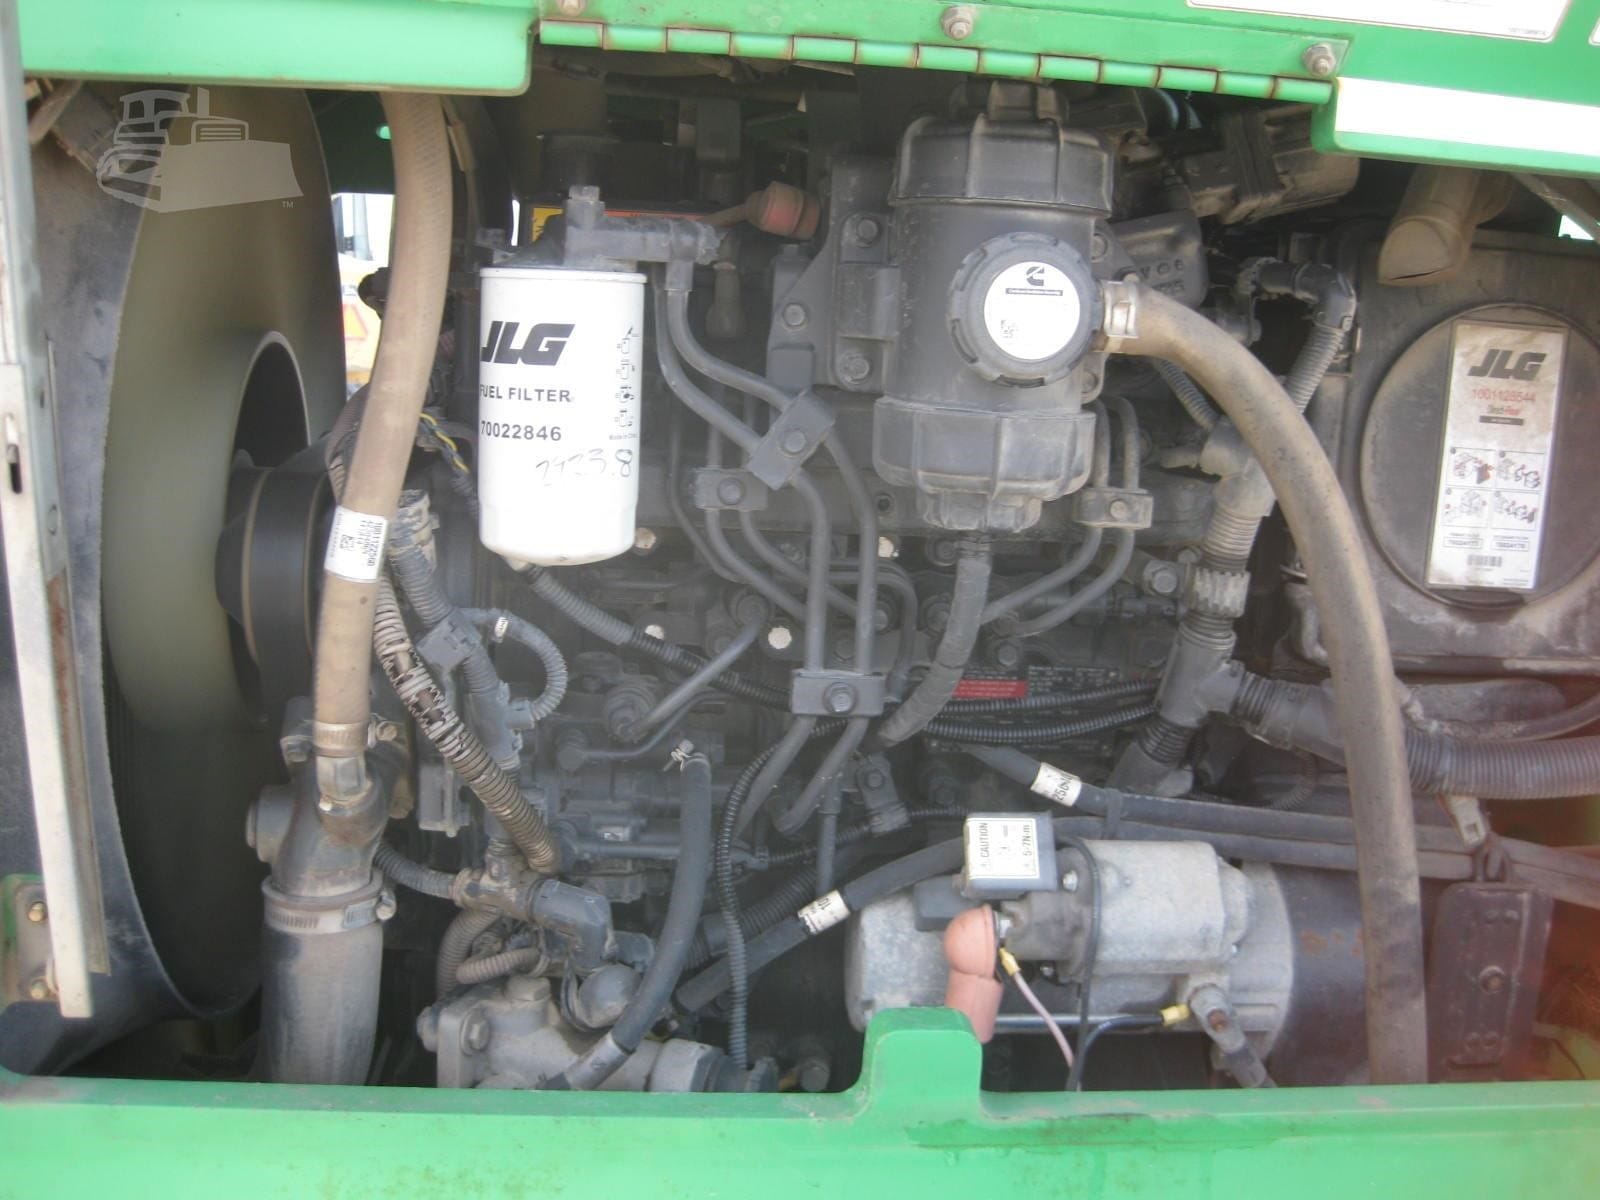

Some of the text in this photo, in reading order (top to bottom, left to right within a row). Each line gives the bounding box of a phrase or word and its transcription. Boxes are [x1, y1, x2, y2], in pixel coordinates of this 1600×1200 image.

[480, 320, 575, 366] JLG
[1467, 349, 1548, 381] JLG
[479, 385, 571, 402] FUEL FILTER
[481, 420, 562, 441] 70022846
[979, 823, 990, 858] CAUTION
